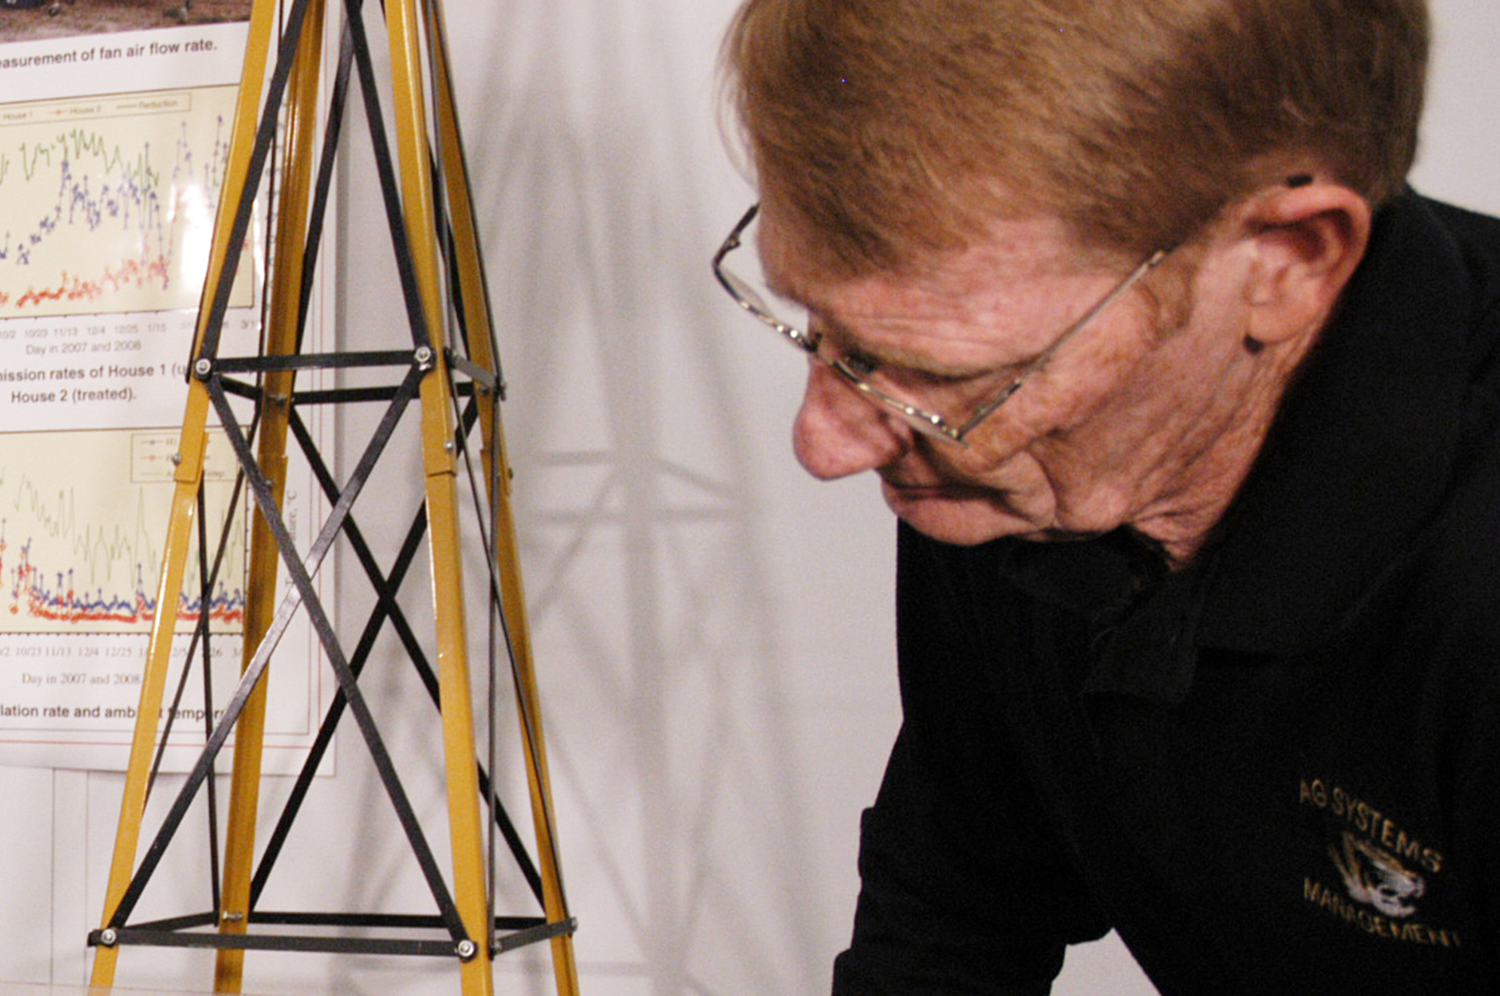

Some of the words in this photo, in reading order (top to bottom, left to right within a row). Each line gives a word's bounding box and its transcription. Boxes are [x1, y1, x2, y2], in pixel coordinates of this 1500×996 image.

[80, 48, 96, 62] of
[100, 47, 122, 60] fan
[126, 43, 145, 57] air
[150, 41, 180, 55] flow
[184, 39, 217, 53] rate.
[49, 366, 85, 380] rates
[89, 365, 104, 378] of
[108, 364, 155, 377] House
[11, 391, 55, 403] House
[72, 388, 136, 403] (treated).
[43, 705, 70, 717] rate
[74, 706, 100, 718] and
[1299, 779, 1327, 807] AG
[1332, 787, 1443, 873] SYSTEMS
